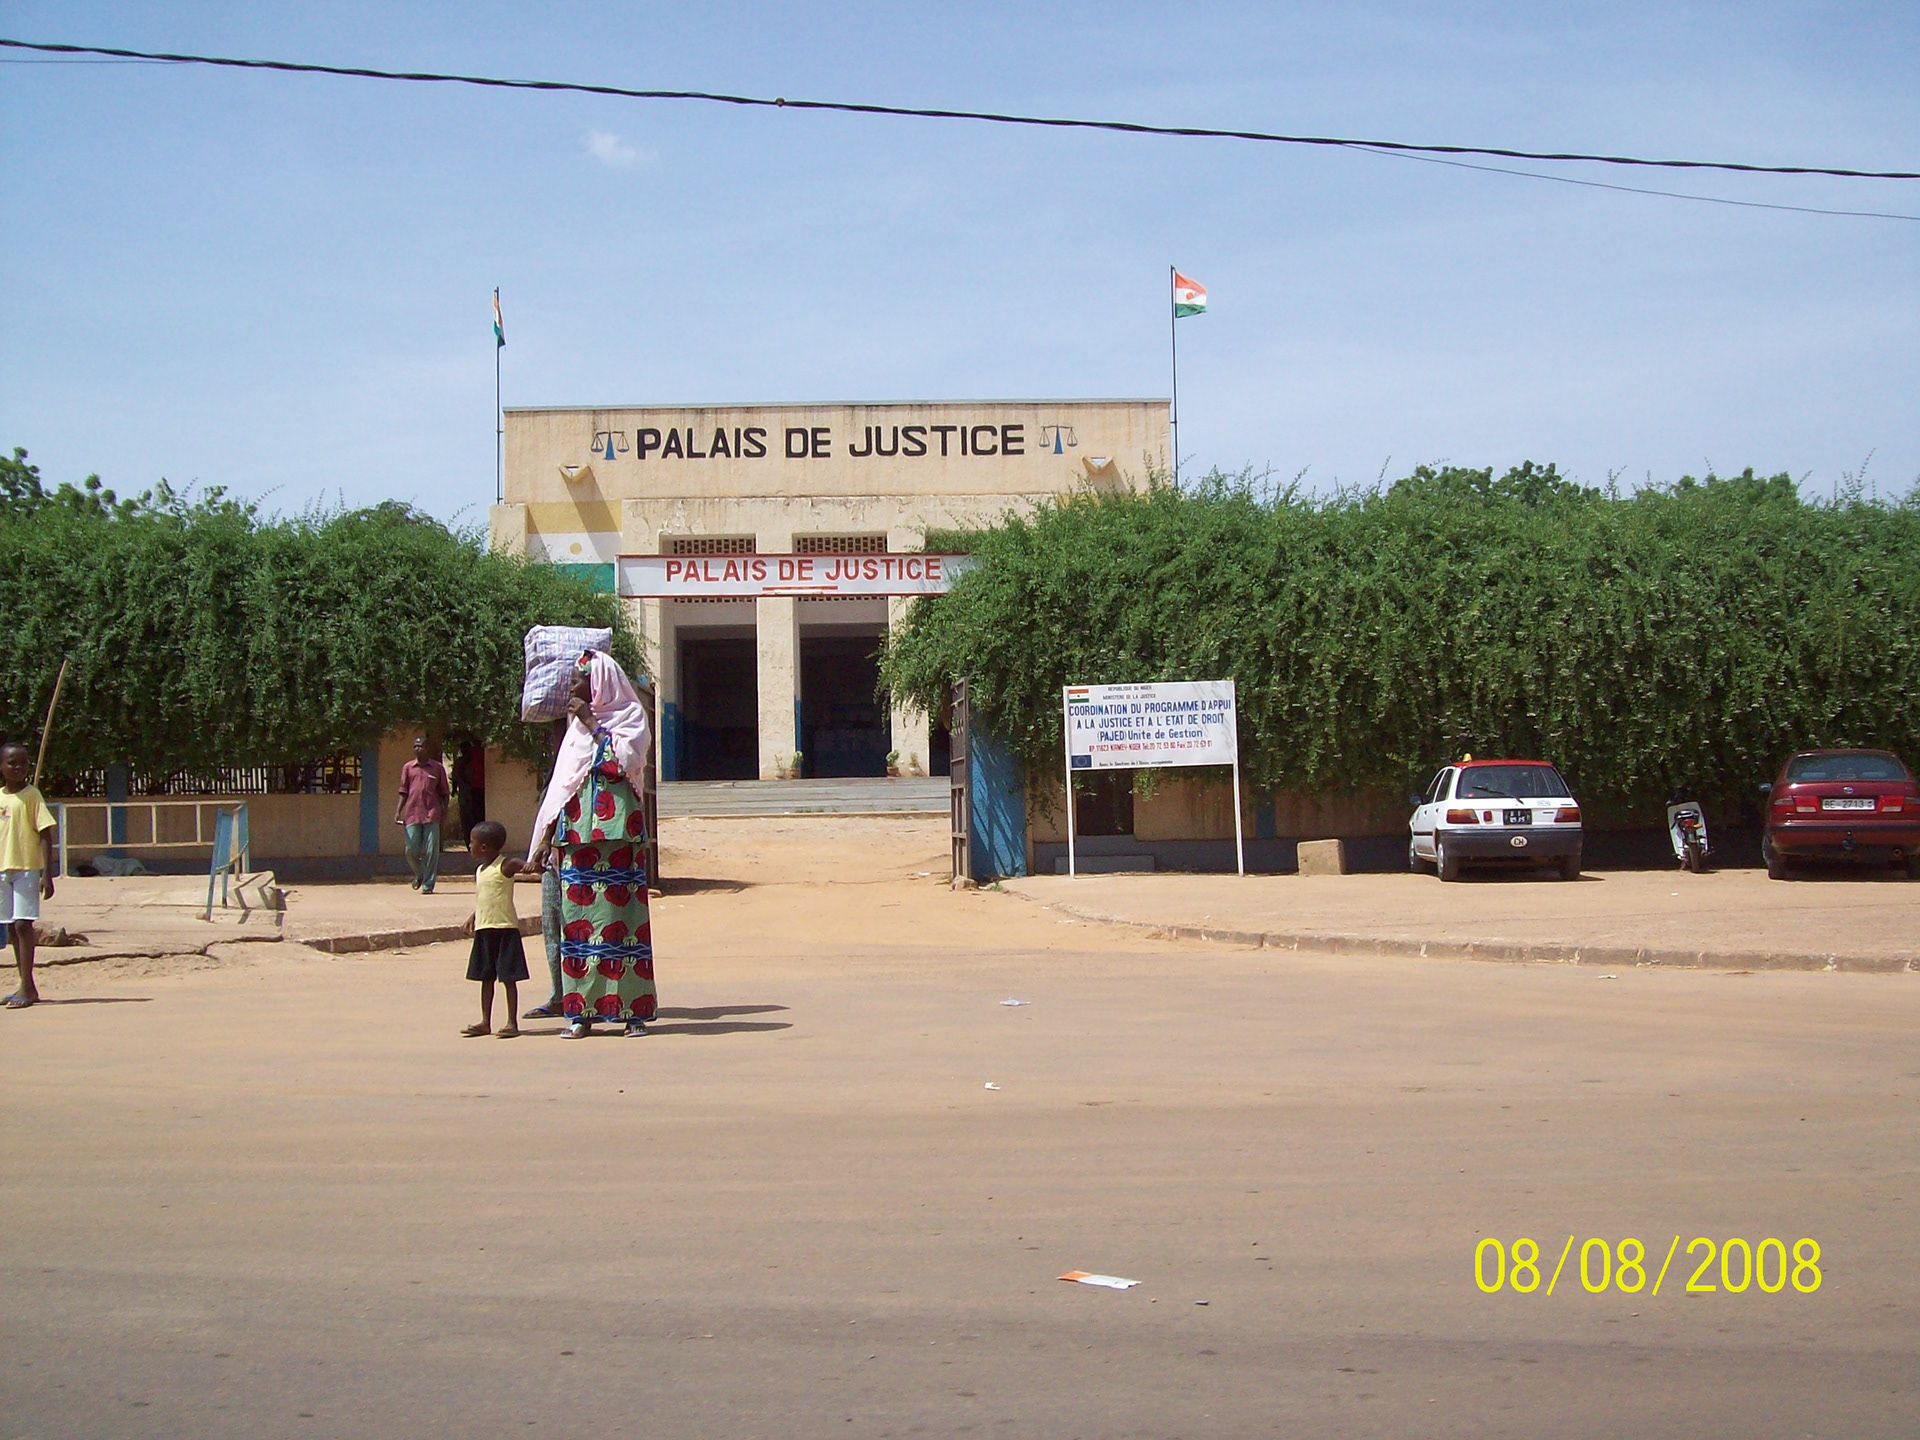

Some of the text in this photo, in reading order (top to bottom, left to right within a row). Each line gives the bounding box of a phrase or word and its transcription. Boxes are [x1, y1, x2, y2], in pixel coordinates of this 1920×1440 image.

[636, 424, 1025, 460] PALAIS DE JUSTICE
[665, 557, 942, 583] PALAIS DE JUSTICE
[1069, 699, 1231, 717] COORDINATION DU PROGRAMME D'APPUI
[1077, 719, 1082, 730] A
[1085, 719, 1095, 729] LA
[1099, 717, 1132, 729] JUSTICE
[1135, 716, 1145, 727] ET
[1148, 716, 1153, 727] A
[1165, 715, 1184, 726] ETAT
[1188, 714, 1198, 725] DE
[1201, 713, 1224, 724] DROIT
[1097, 728, 1203, 742] (PAJED) Unite de Gestion
[1842, 800, 1864, 808] 2713
[1513, 837, 1524, 846] CH
